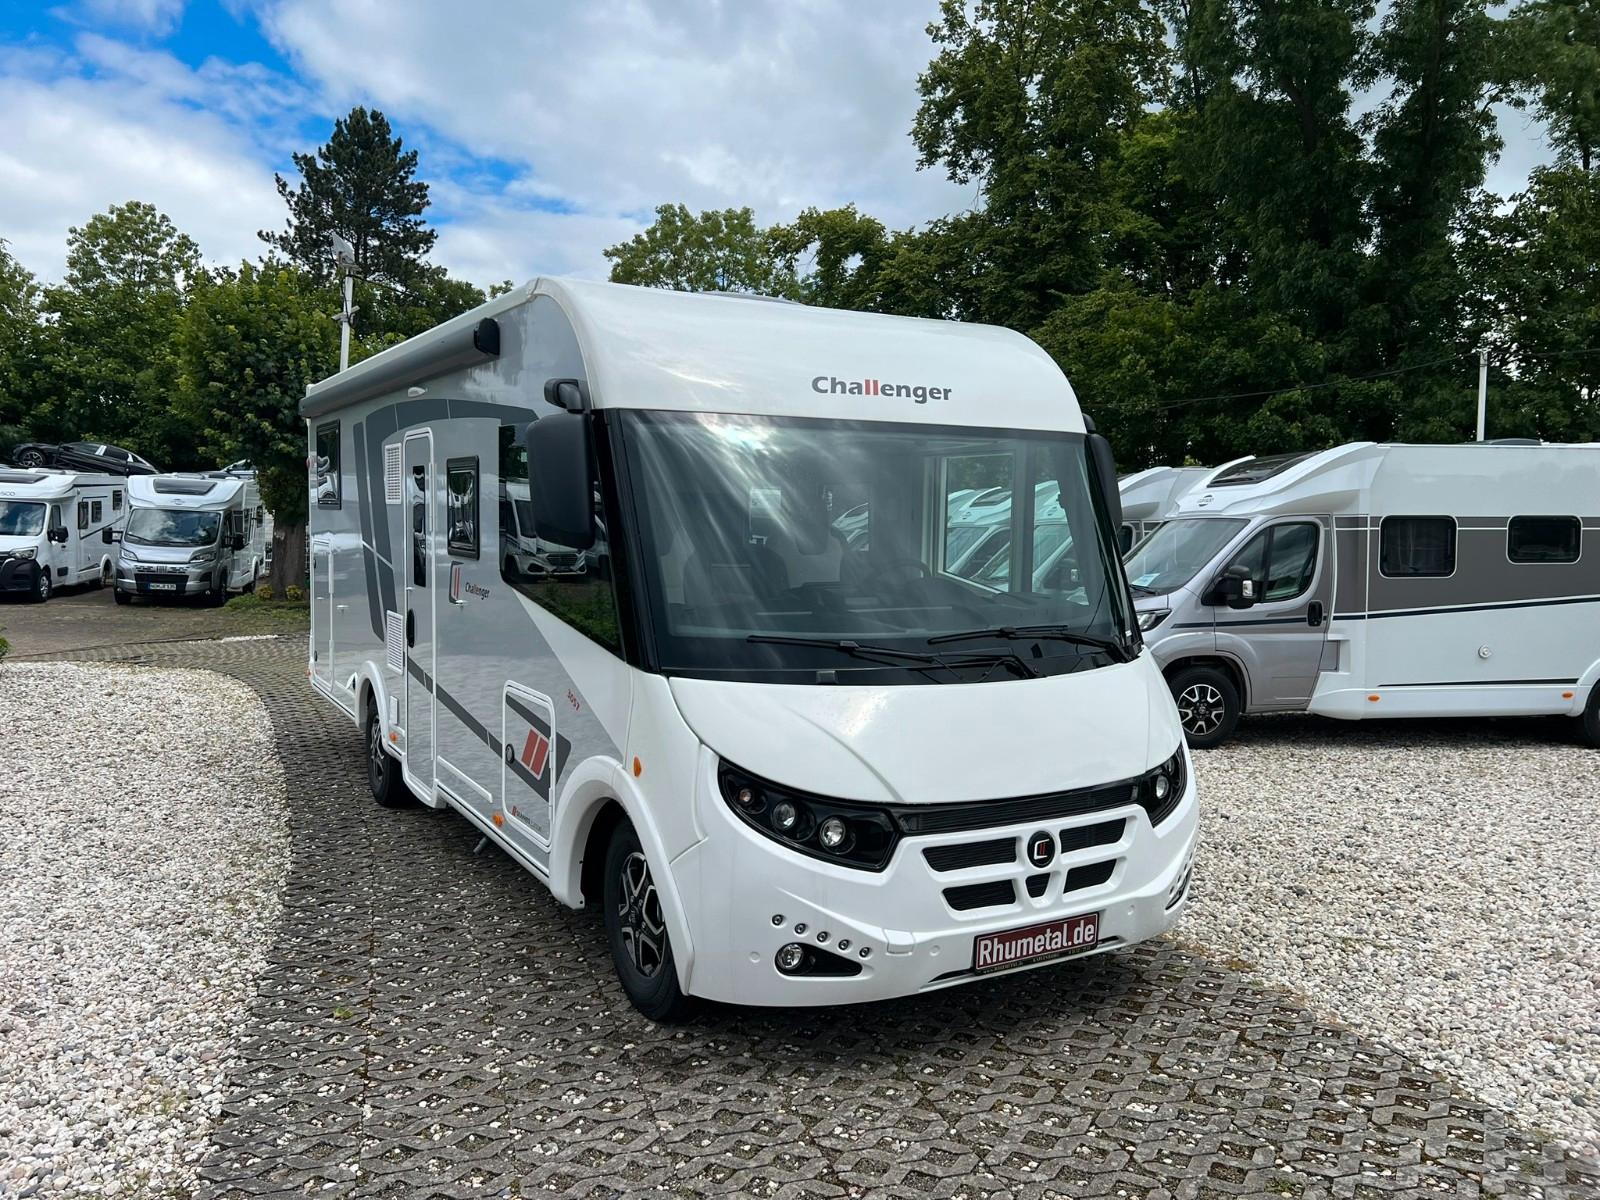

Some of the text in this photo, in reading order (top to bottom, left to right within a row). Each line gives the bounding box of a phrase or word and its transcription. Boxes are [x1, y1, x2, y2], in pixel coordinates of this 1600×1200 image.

[811, 376, 953, 405] Challenger
[465, 582, 490, 600] Challenger
[979, 920, 1095, 966] Rhumetal.de
